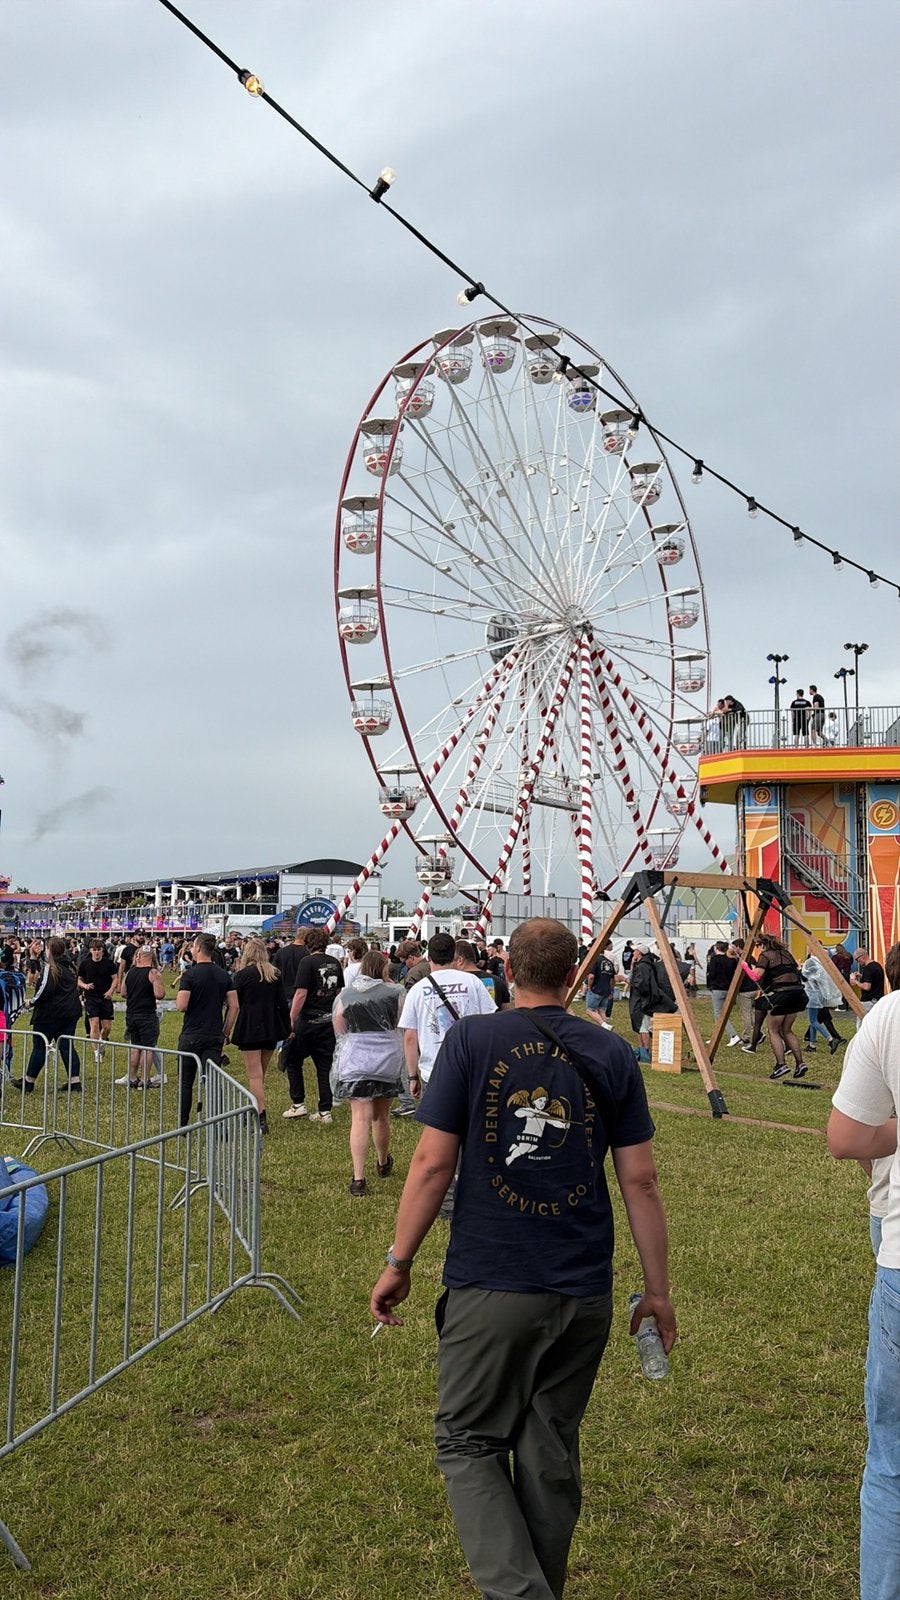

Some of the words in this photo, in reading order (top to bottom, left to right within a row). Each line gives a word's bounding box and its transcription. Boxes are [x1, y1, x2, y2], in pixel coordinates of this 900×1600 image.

[485, 1060, 510, 1142] DENHAM
[510, 1042, 545, 1060] THE
[516, 1134, 539, 1142] DENIM
[491, 1174, 561, 1216] SERVICE
